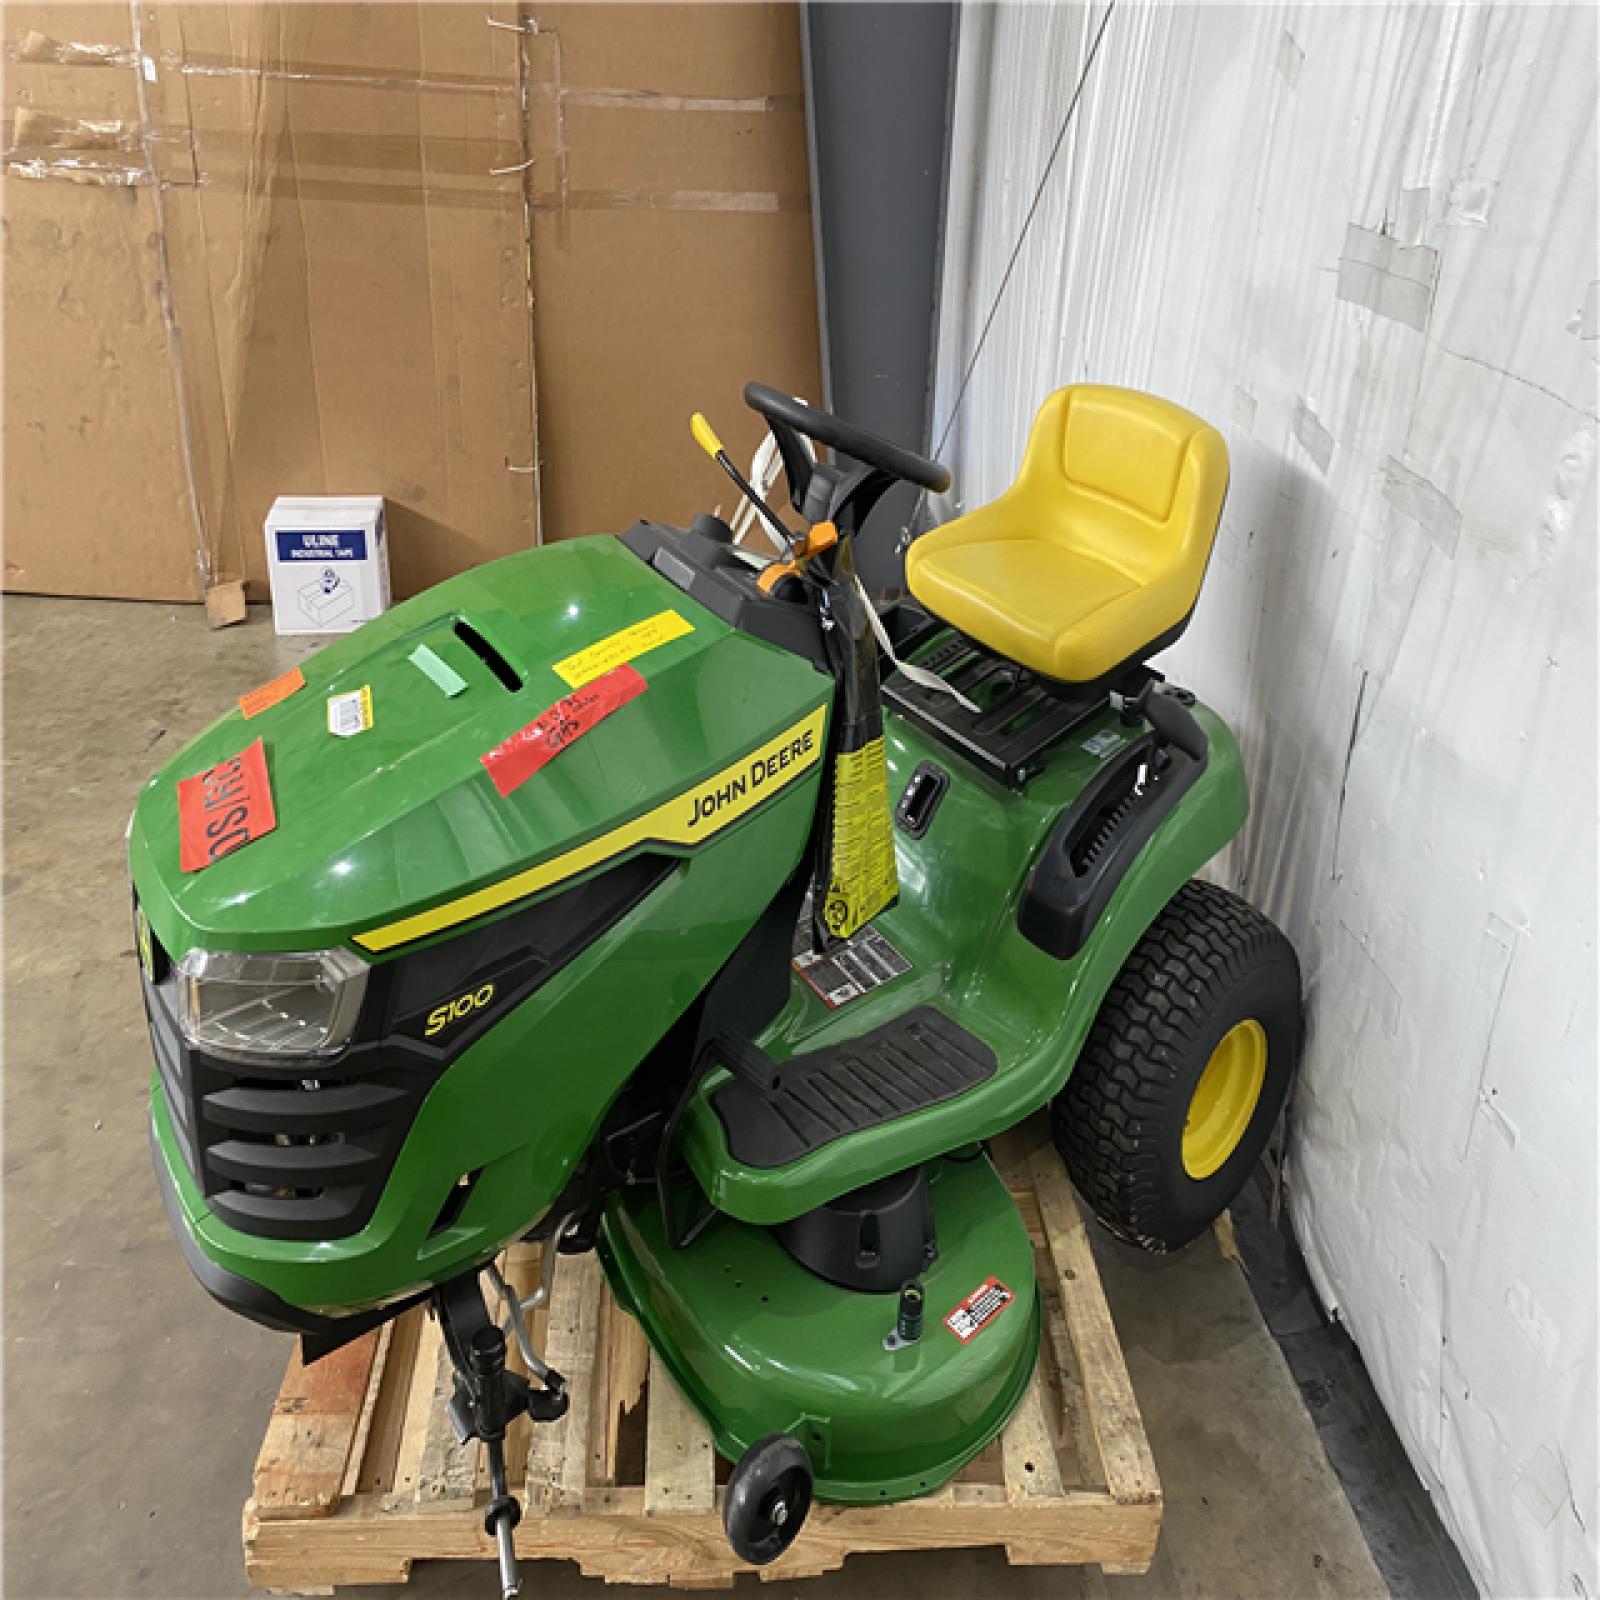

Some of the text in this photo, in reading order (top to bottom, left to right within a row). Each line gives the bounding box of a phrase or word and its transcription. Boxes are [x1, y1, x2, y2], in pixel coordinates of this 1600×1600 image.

[687, 729, 814, 828] JOHN DEERE
[424, 984, 494, 1036] S100
